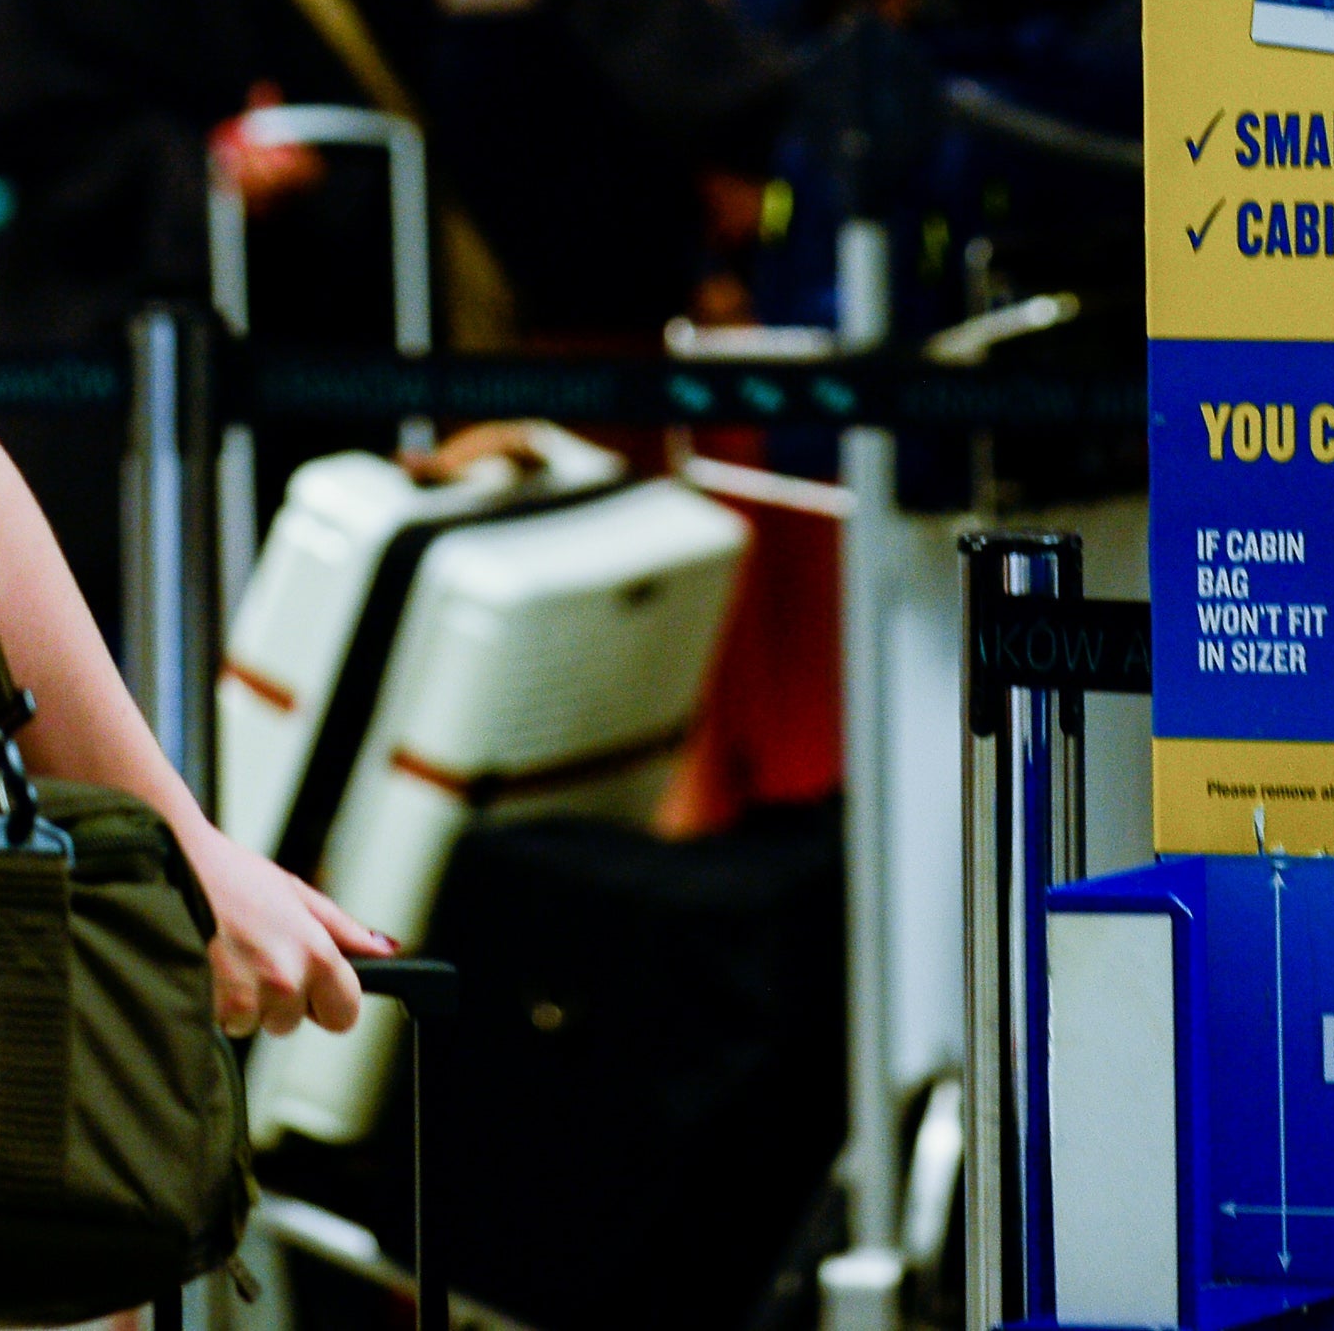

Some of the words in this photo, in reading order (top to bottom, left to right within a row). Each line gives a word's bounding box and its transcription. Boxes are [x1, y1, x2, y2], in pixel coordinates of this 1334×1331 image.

[1201, 403, 1295, 462] YOU
[1198, 530, 1220, 560] IF
[1227, 530, 1304, 562] CABIN
[1198, 567, 1248, 598] BAG
[1198, 604, 1282, 635] WON'T
[1288, 605, 1327, 637] FIT
[1199, 641, 1224, 671] IN
[1232, 641, 1306, 673] SIZER
